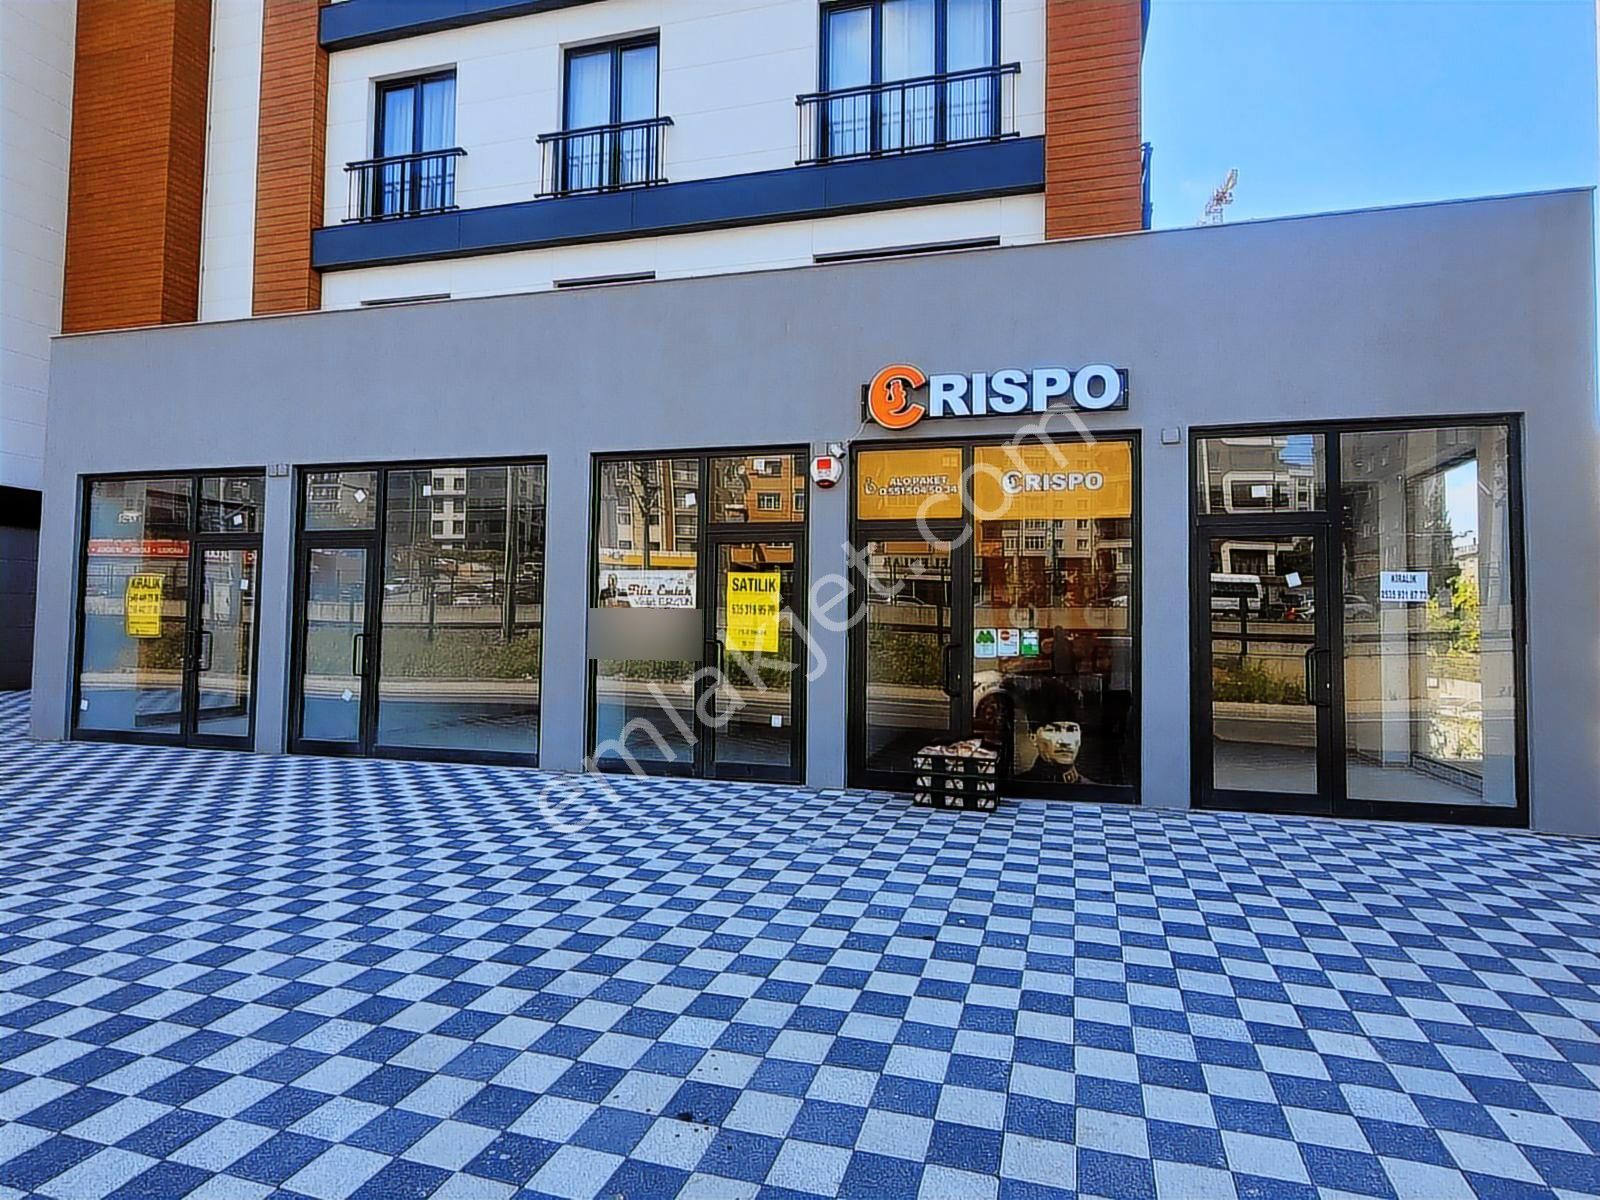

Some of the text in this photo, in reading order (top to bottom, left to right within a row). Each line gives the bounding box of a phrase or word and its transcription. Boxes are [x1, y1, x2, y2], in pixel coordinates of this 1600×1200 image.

[868, 363, 1121, 429] CRISPO
[1003, 470, 1104, 494] CRISPO
[657, 583, 692, 596] Emlak
[731, 577, 777, 593] SATILIK
